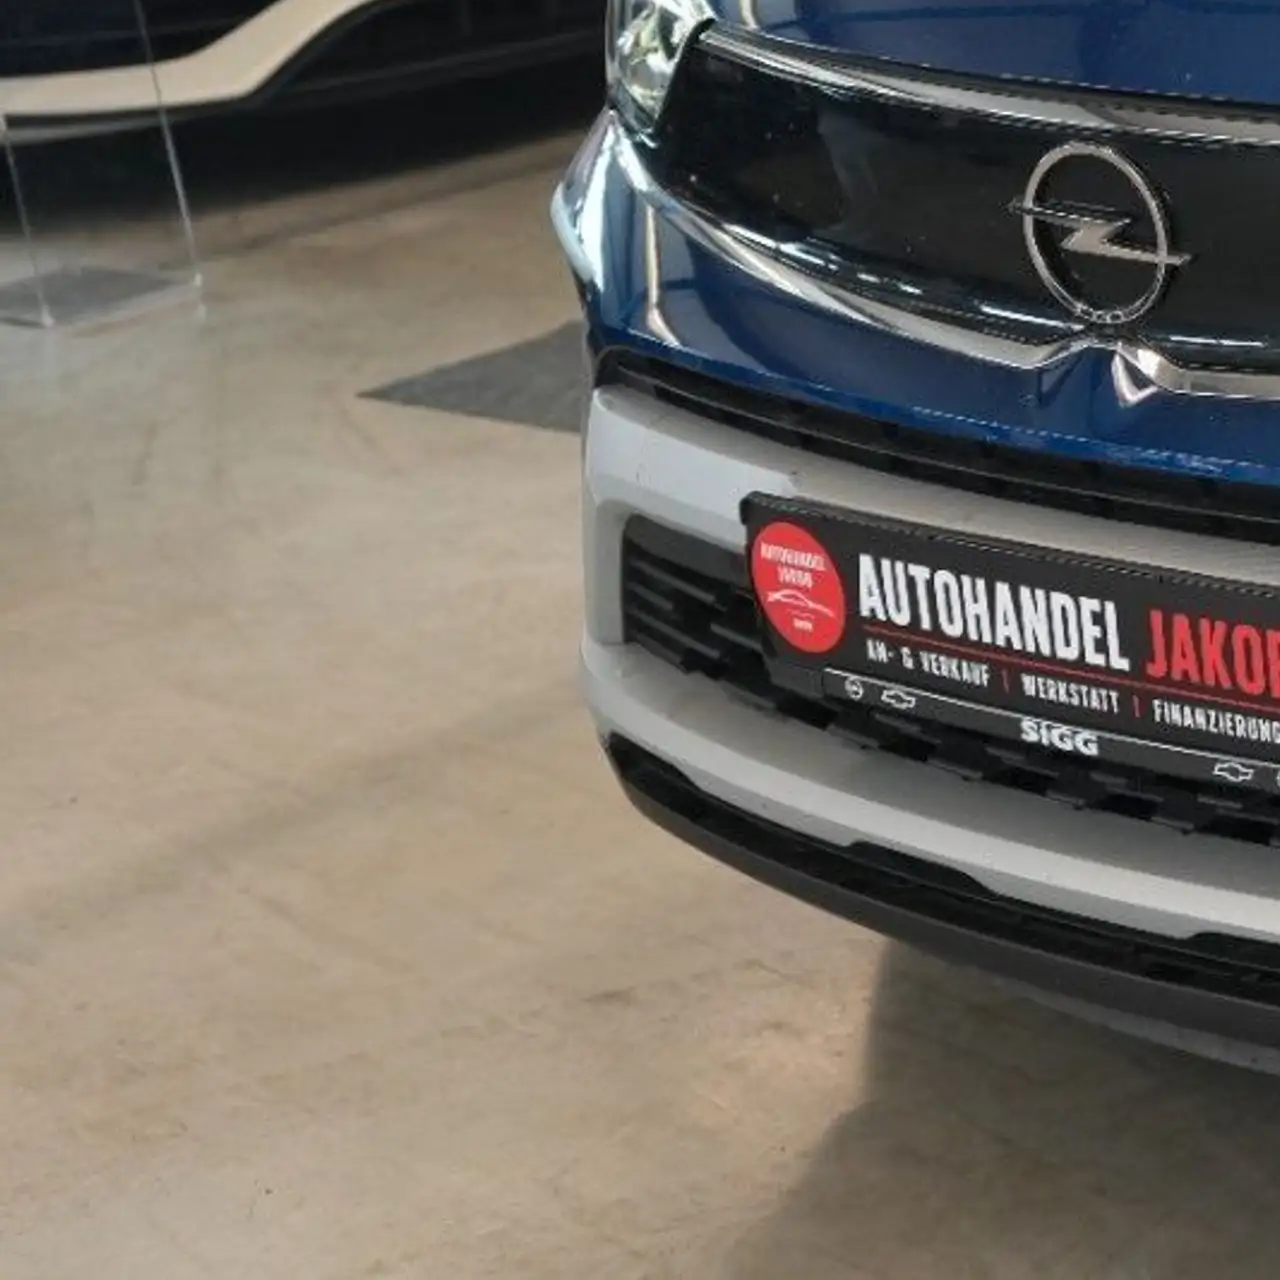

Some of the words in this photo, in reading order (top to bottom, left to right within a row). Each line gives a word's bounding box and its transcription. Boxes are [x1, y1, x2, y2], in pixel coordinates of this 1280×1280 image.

[858, 553, 1130, 672] AUTOHANDEL
[1020, 672, 1120, 716] WERKSTATT
[1020, 716, 1099, 756] SIGG
